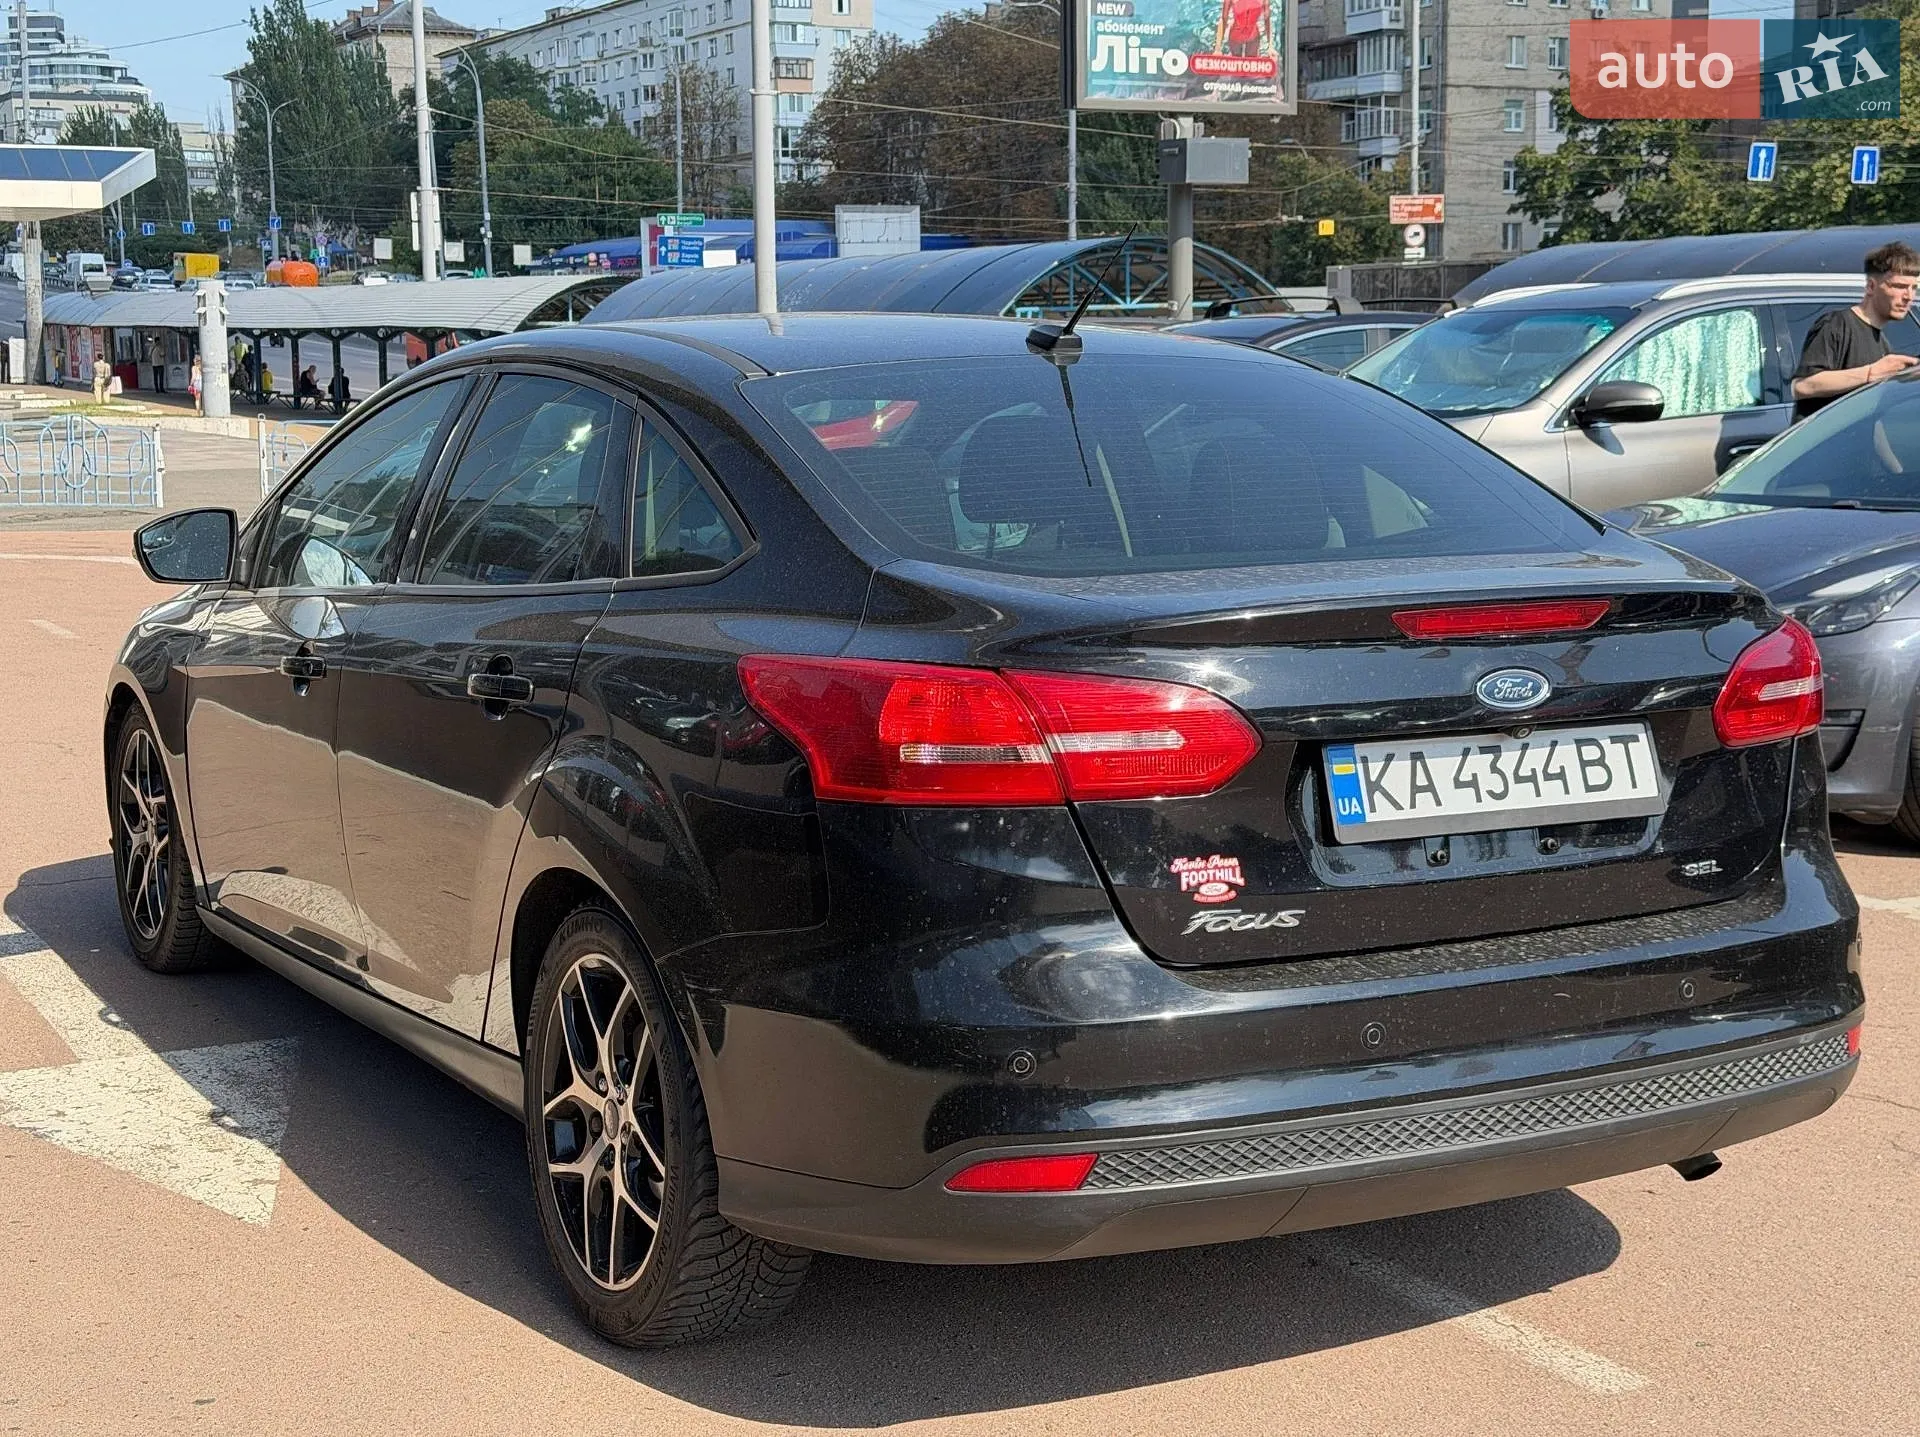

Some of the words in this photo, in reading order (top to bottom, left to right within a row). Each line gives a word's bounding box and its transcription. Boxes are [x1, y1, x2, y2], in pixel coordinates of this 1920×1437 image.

[1096, 2, 1126, 15] NEW
[1096, 20, 1165, 35] абонемент
[1091, 34, 1189, 76] Літо
[1195, 58, 1273, 73] БЕЗКОШТОВНО
[1494, 677, 1534, 699] Ford
[1361, 751, 1442, 813] KA
[1453, 740, 1569, 803] 4344
[1573, 734, 1640, 794] BT
[1338, 797, 1362, 816] UA
[1680, 860, 1723, 877] SEL
[1180, 866, 1246, 892] FOOTHILL
